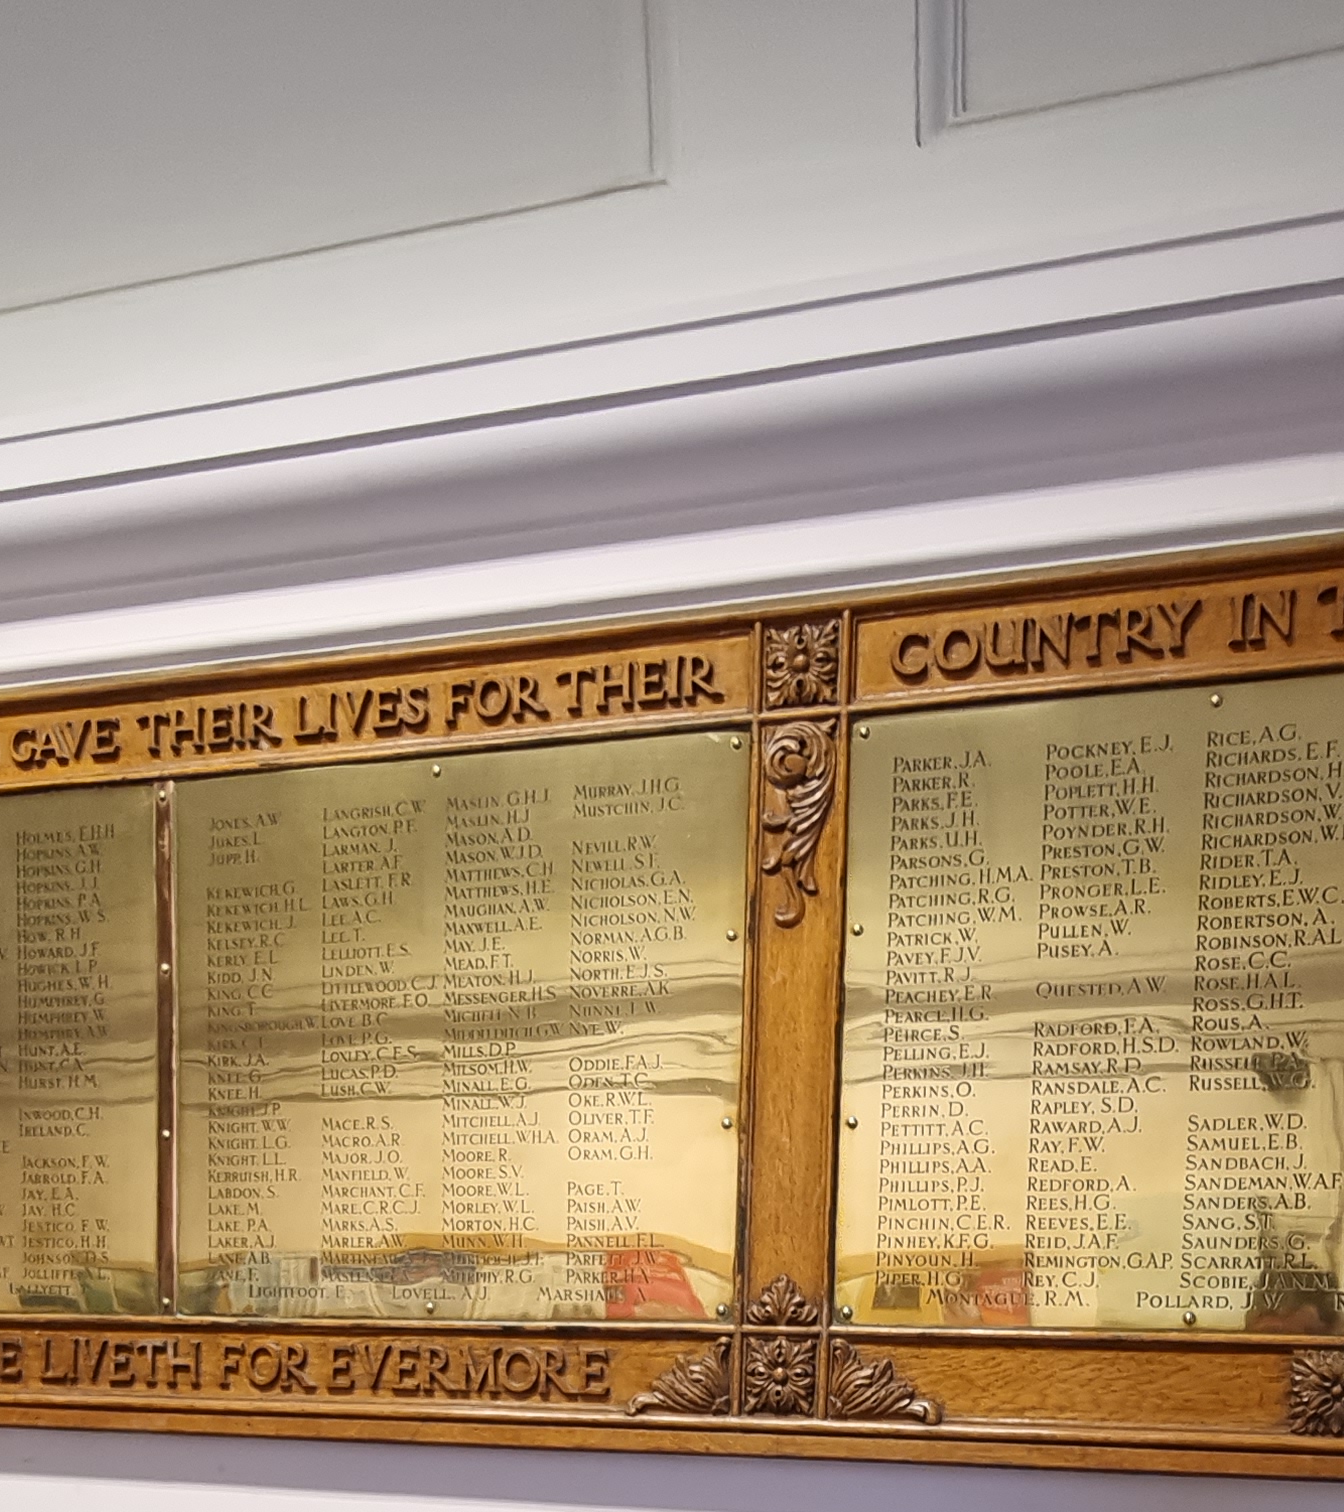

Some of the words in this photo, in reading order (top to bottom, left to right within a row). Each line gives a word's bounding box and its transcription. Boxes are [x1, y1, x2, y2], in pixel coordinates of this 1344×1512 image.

[10, 717, 122, 771] GAVE
[136, 701, 282, 757] THEIR
[294, 686, 430, 744] LIVES
[444, 673, 551, 730] FOR
[557, 653, 725, 718] THEIR
[890, 597, 1204, 686] COUNTRY
[1228, 589, 1297, 653] IN
[40, 1336, 203, 1390] LIVETH
[220, 1342, 318, 1392] FOR
[327, 1343, 613, 1399] EVERMORE
